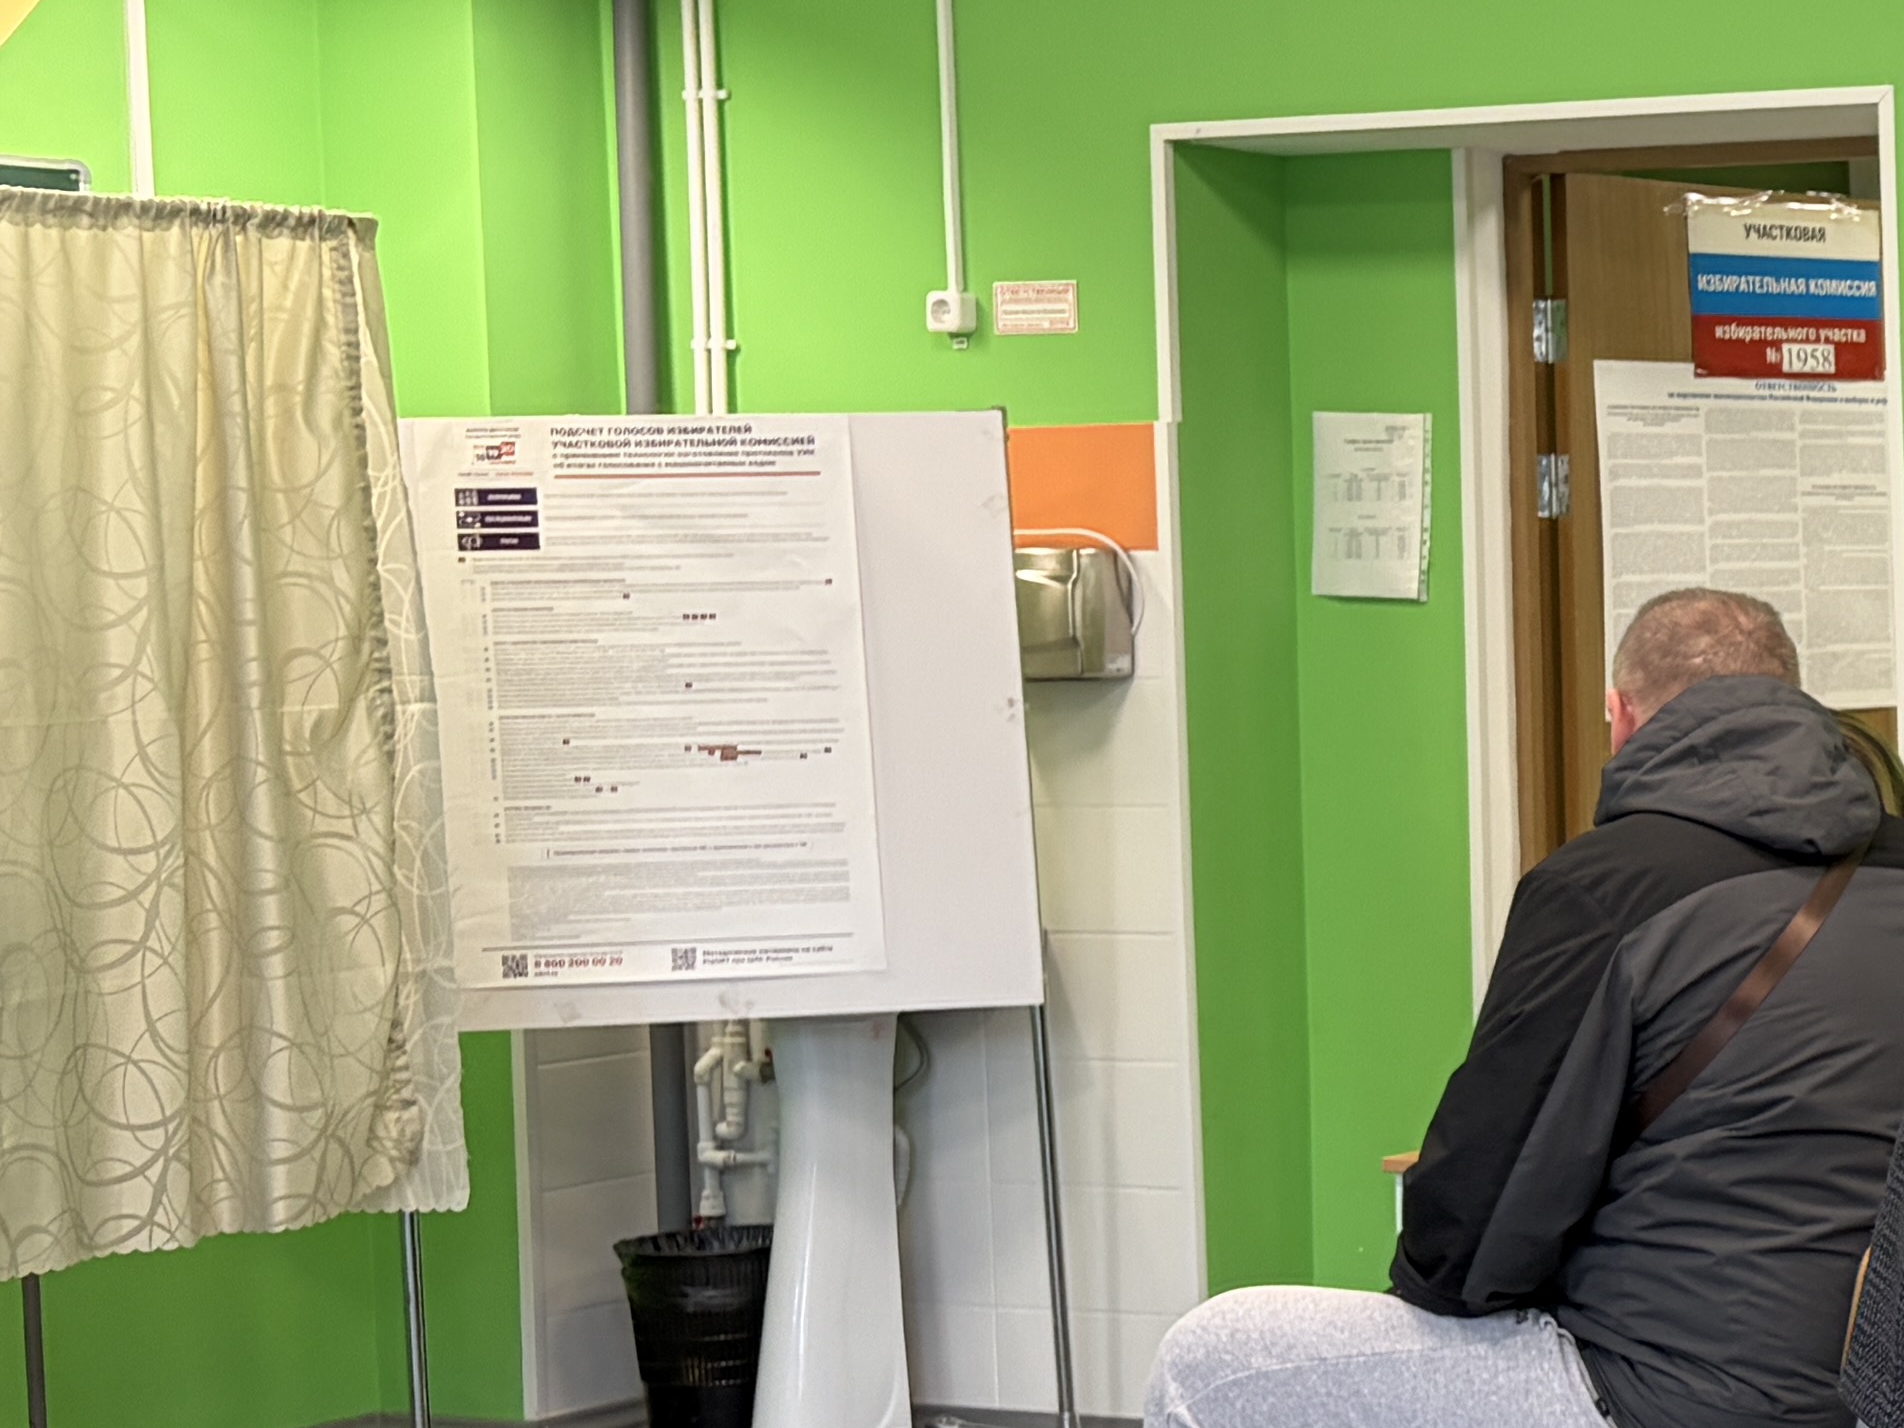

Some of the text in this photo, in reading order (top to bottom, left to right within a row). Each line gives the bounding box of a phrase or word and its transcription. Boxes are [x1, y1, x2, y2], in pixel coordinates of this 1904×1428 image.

[1744, 223, 1827, 243] УЧАСТКОВАЯ
[1697, 273, 1877, 297] ИЗБИРАТЕЛЬНАЯ КОМИССИЯ
[1714, 322, 1867, 344] избирательного участка
[1786, 346, 1833, 371] 1958
